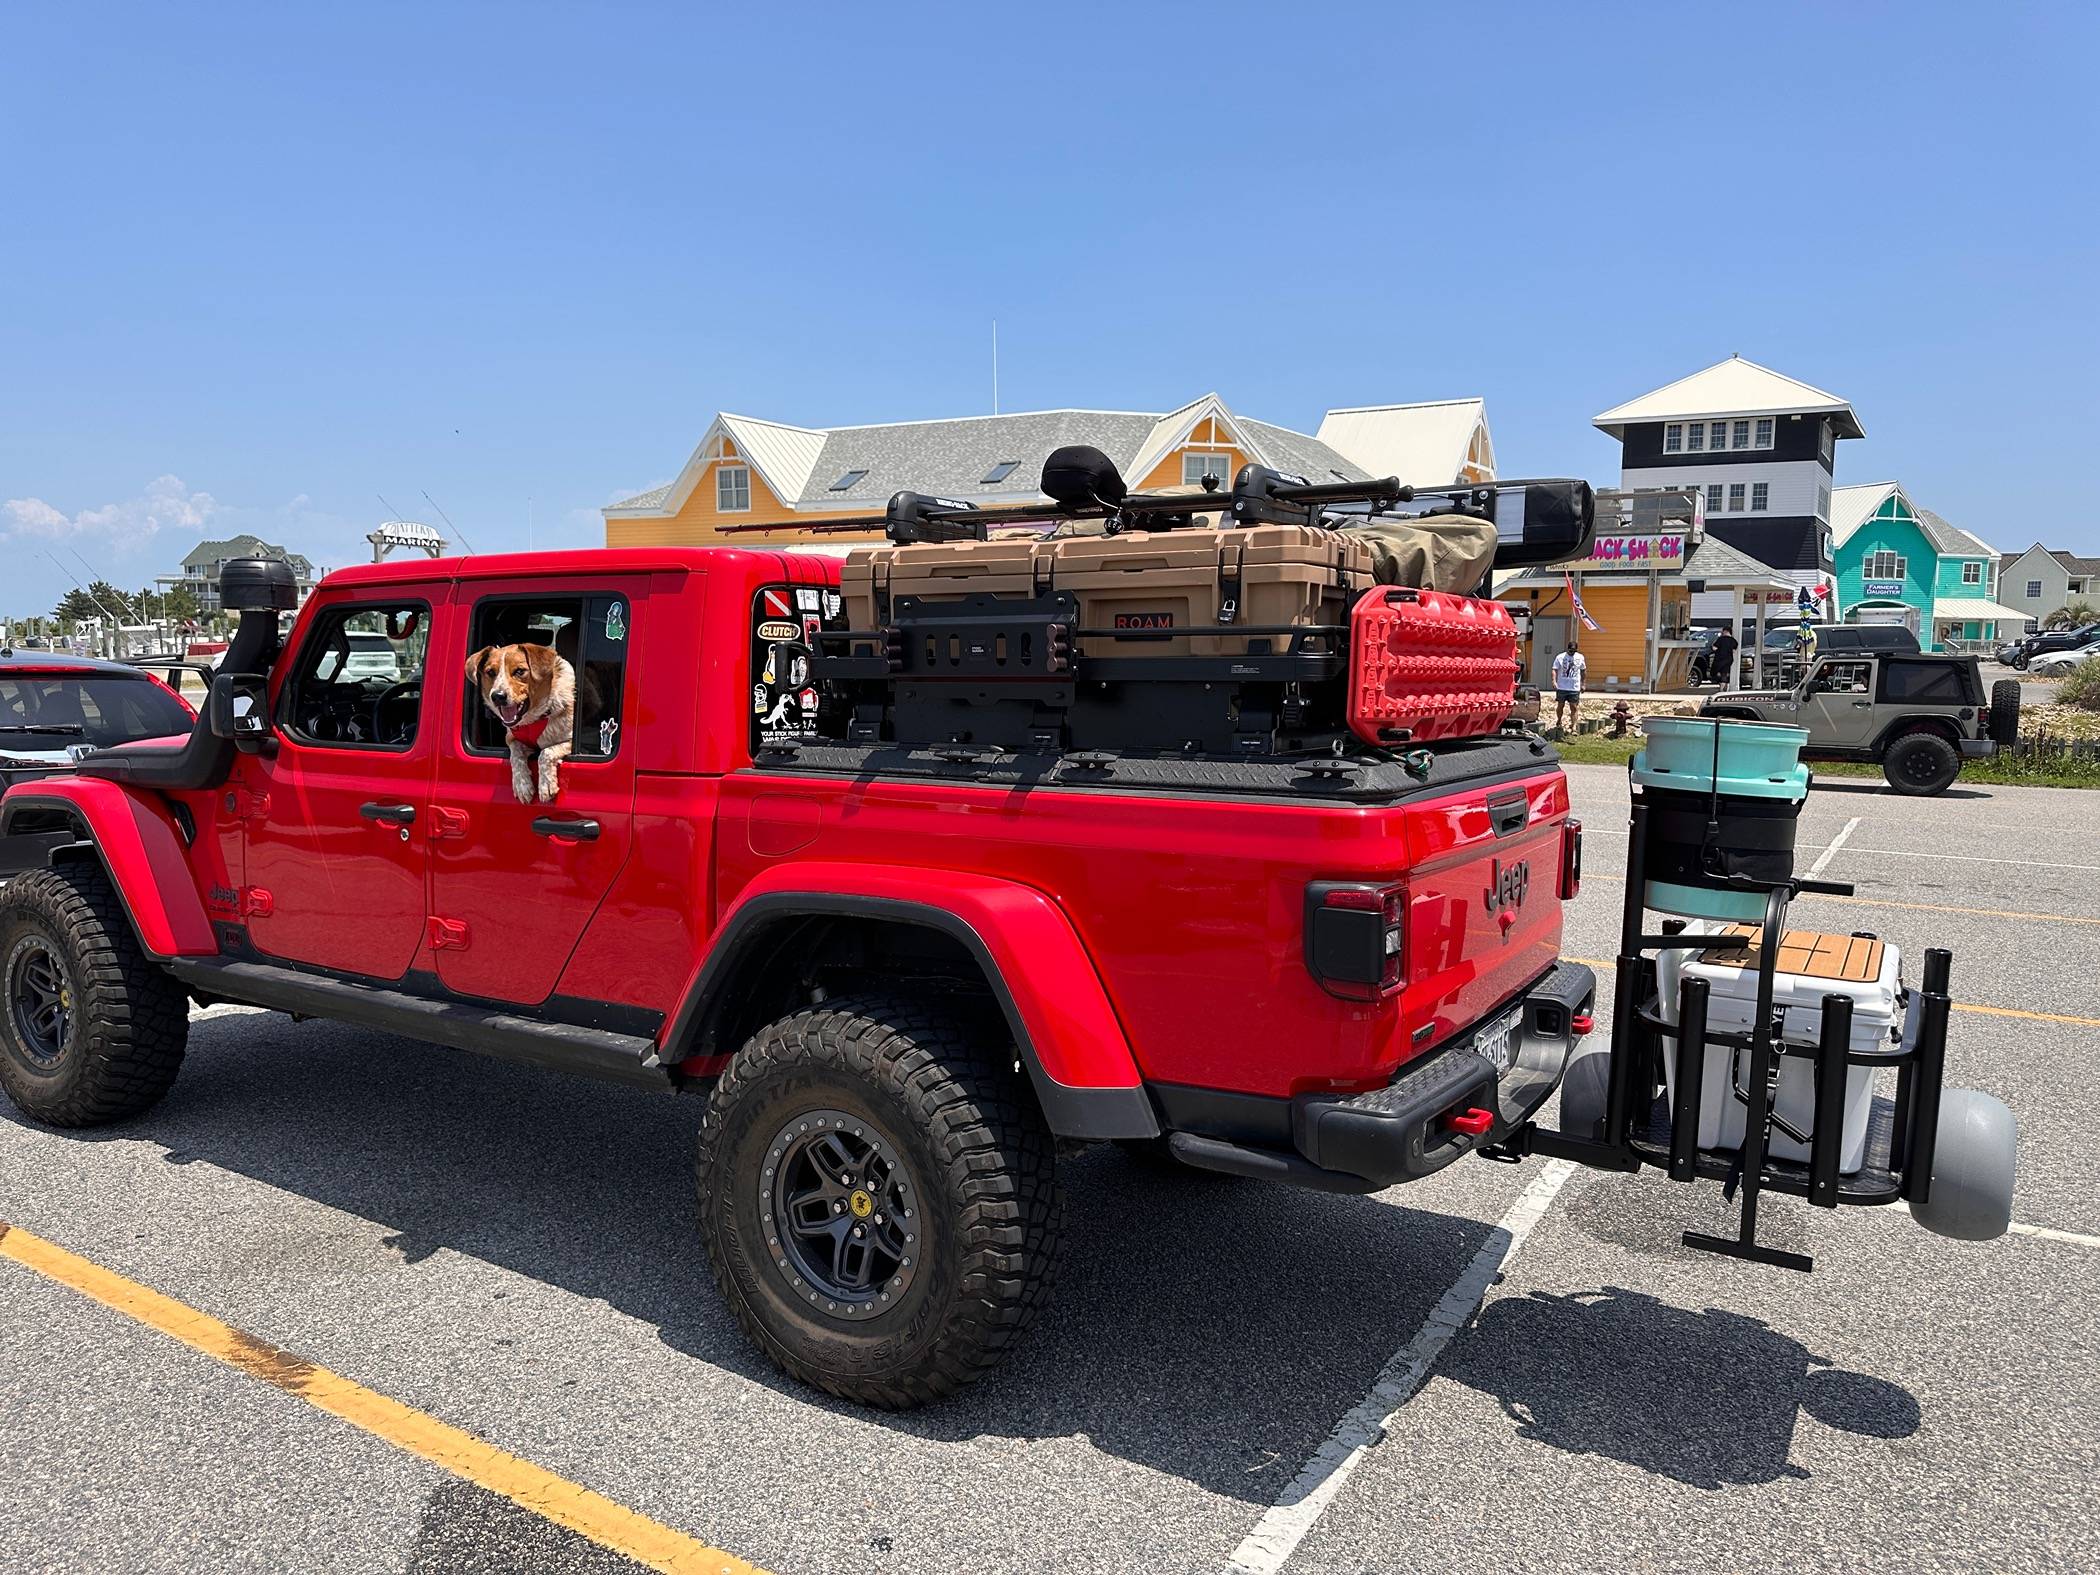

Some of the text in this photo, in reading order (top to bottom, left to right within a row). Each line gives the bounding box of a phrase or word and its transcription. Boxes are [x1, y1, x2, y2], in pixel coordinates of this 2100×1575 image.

[386, 536, 439, 547] MARINA
[1576, 538, 1624, 561] ACK
[1600, 561, 1616, 569] GOOD
[1638, 560, 1652, 568] FAST
[1117, 616, 1170, 629] ROAM
[761, 626, 797, 636] CLUTCH
[1484, 858, 1529, 912] Jeep
[208, 881, 239, 907] Jeep
